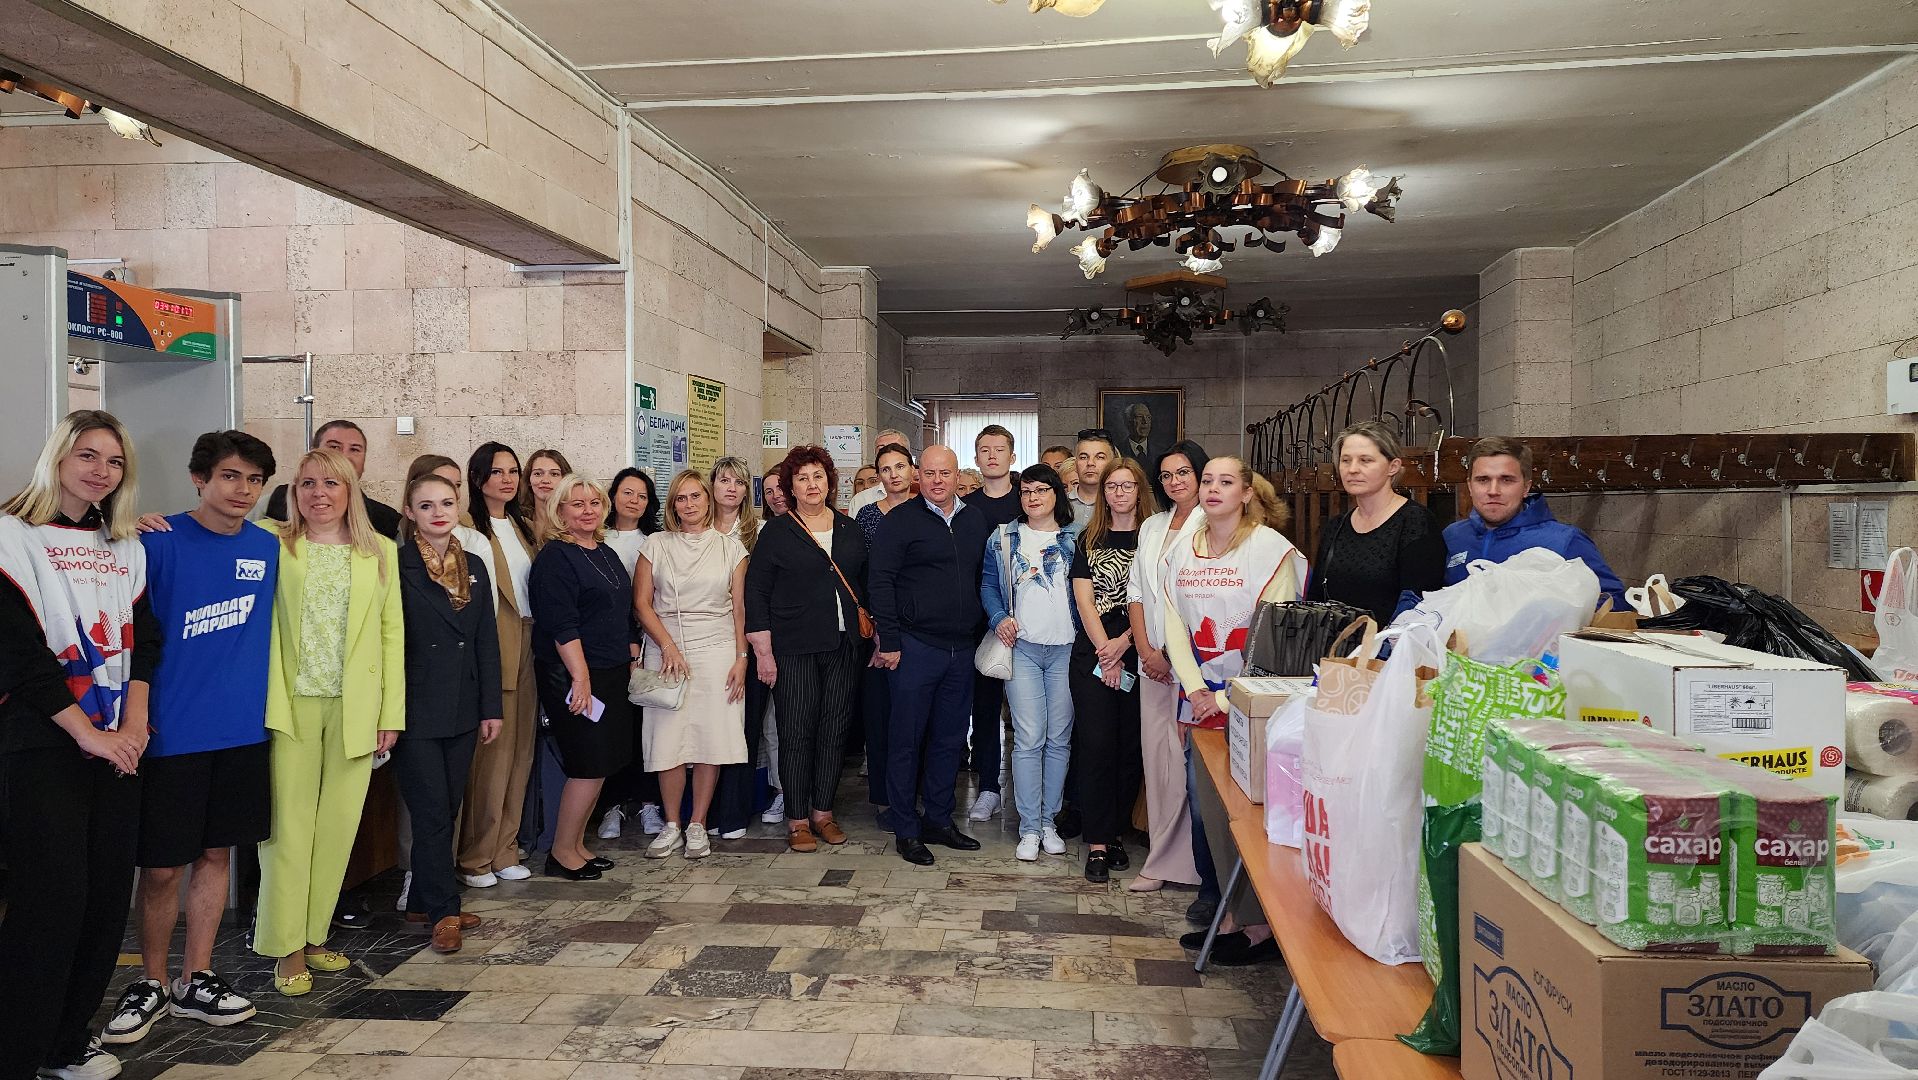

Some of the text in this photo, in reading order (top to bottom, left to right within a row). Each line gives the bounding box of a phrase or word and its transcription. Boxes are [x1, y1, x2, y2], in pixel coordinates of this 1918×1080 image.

[1644, 836, 1722, 860] сахар
[1754, 837, 1829, 861] сахар
[1716, 981, 1756, 992] МАСЛО
[1505, 979, 1532, 1020] МАСЛО
[1687, 994, 1785, 1019] ЗЛАТО
[1634, 1050, 1667, 1058] масло
[1661, 1068, 1686, 1077] ГОСТ
